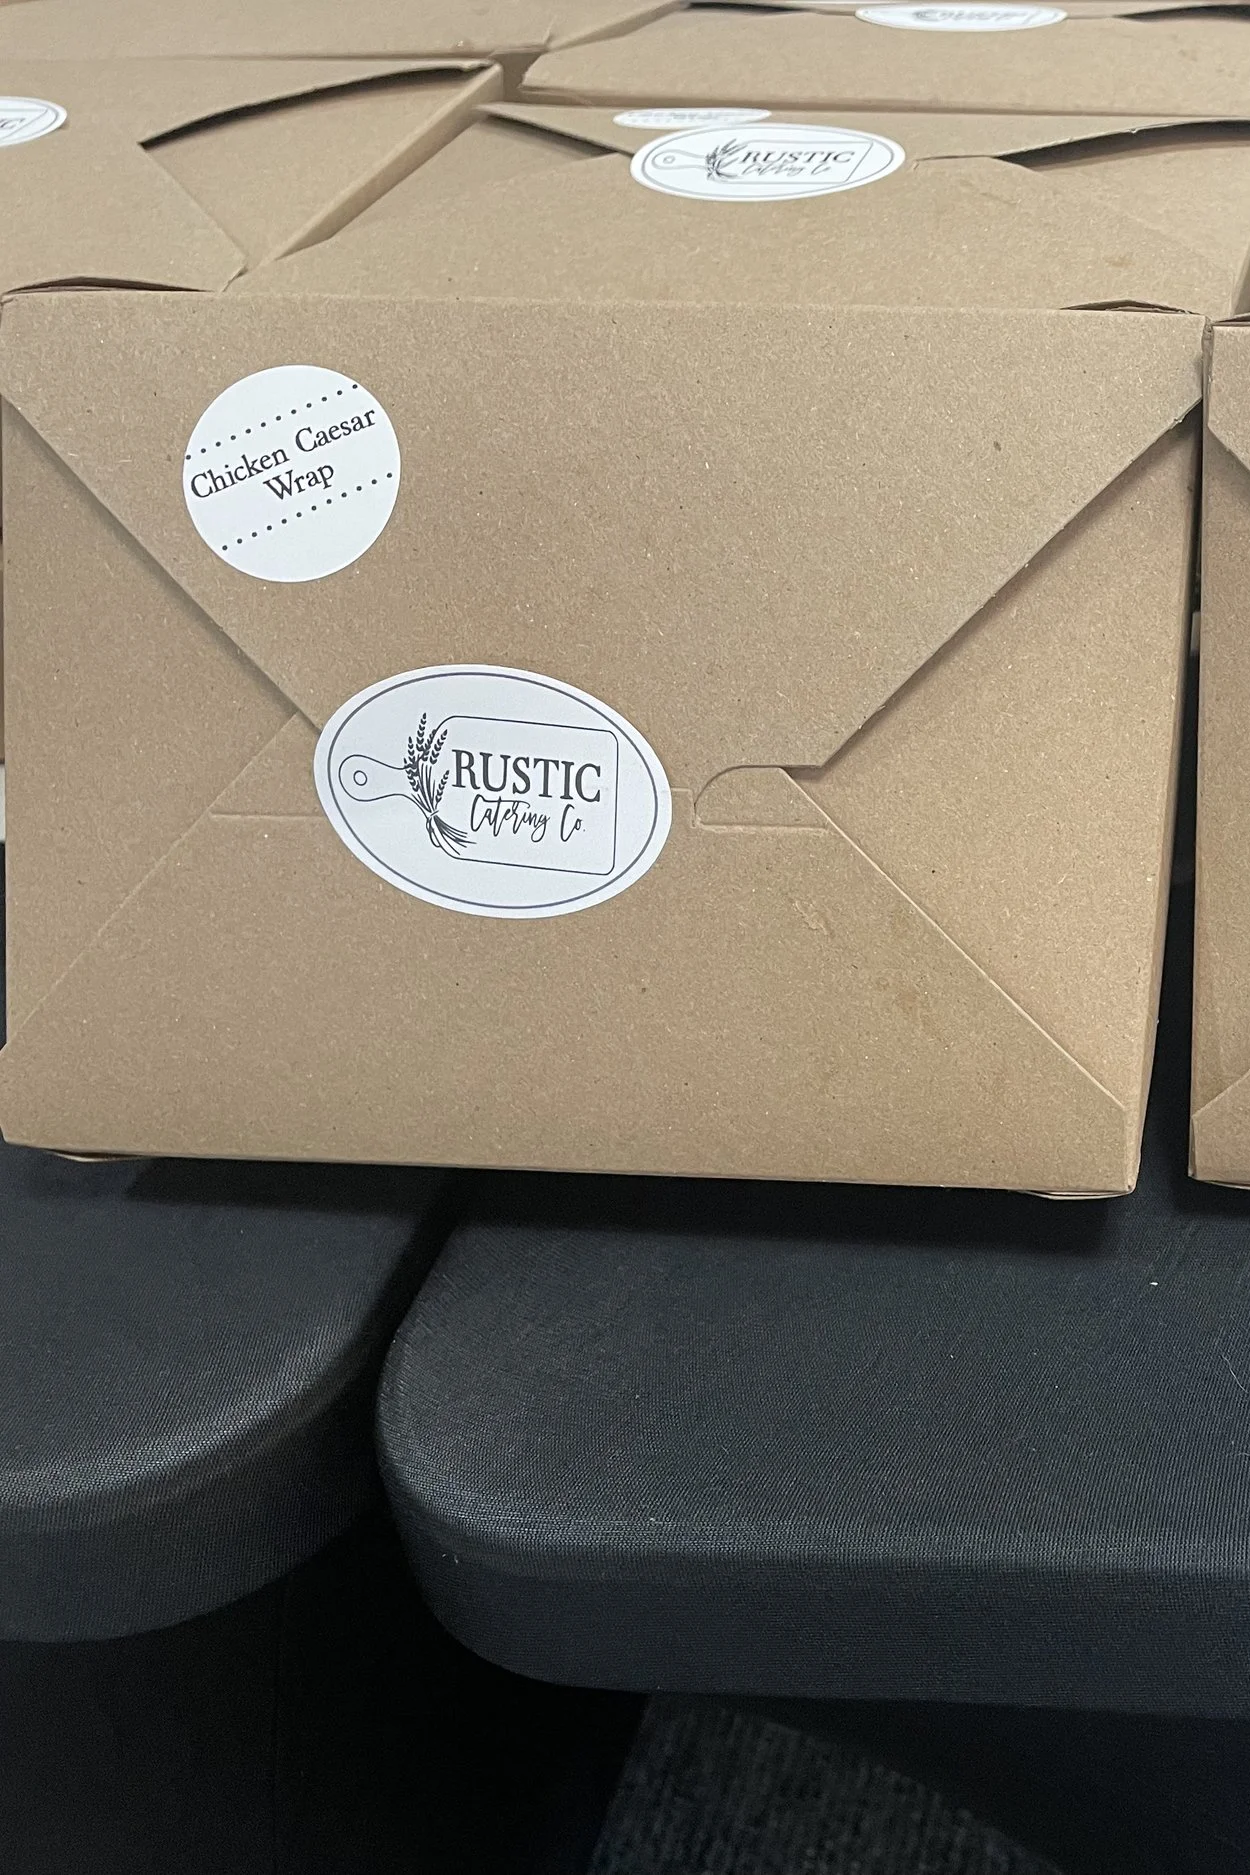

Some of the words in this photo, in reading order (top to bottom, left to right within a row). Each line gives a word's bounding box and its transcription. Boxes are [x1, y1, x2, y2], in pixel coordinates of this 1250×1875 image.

[740, 150, 856, 164] RUSTIC
[190, 448, 290, 499] Chicken
[294, 409, 376, 452] Caesar
[262, 464, 335, 501] Wrap
[451, 748, 601, 803] RUSTIC
[470, 793, 551, 843] Catering
